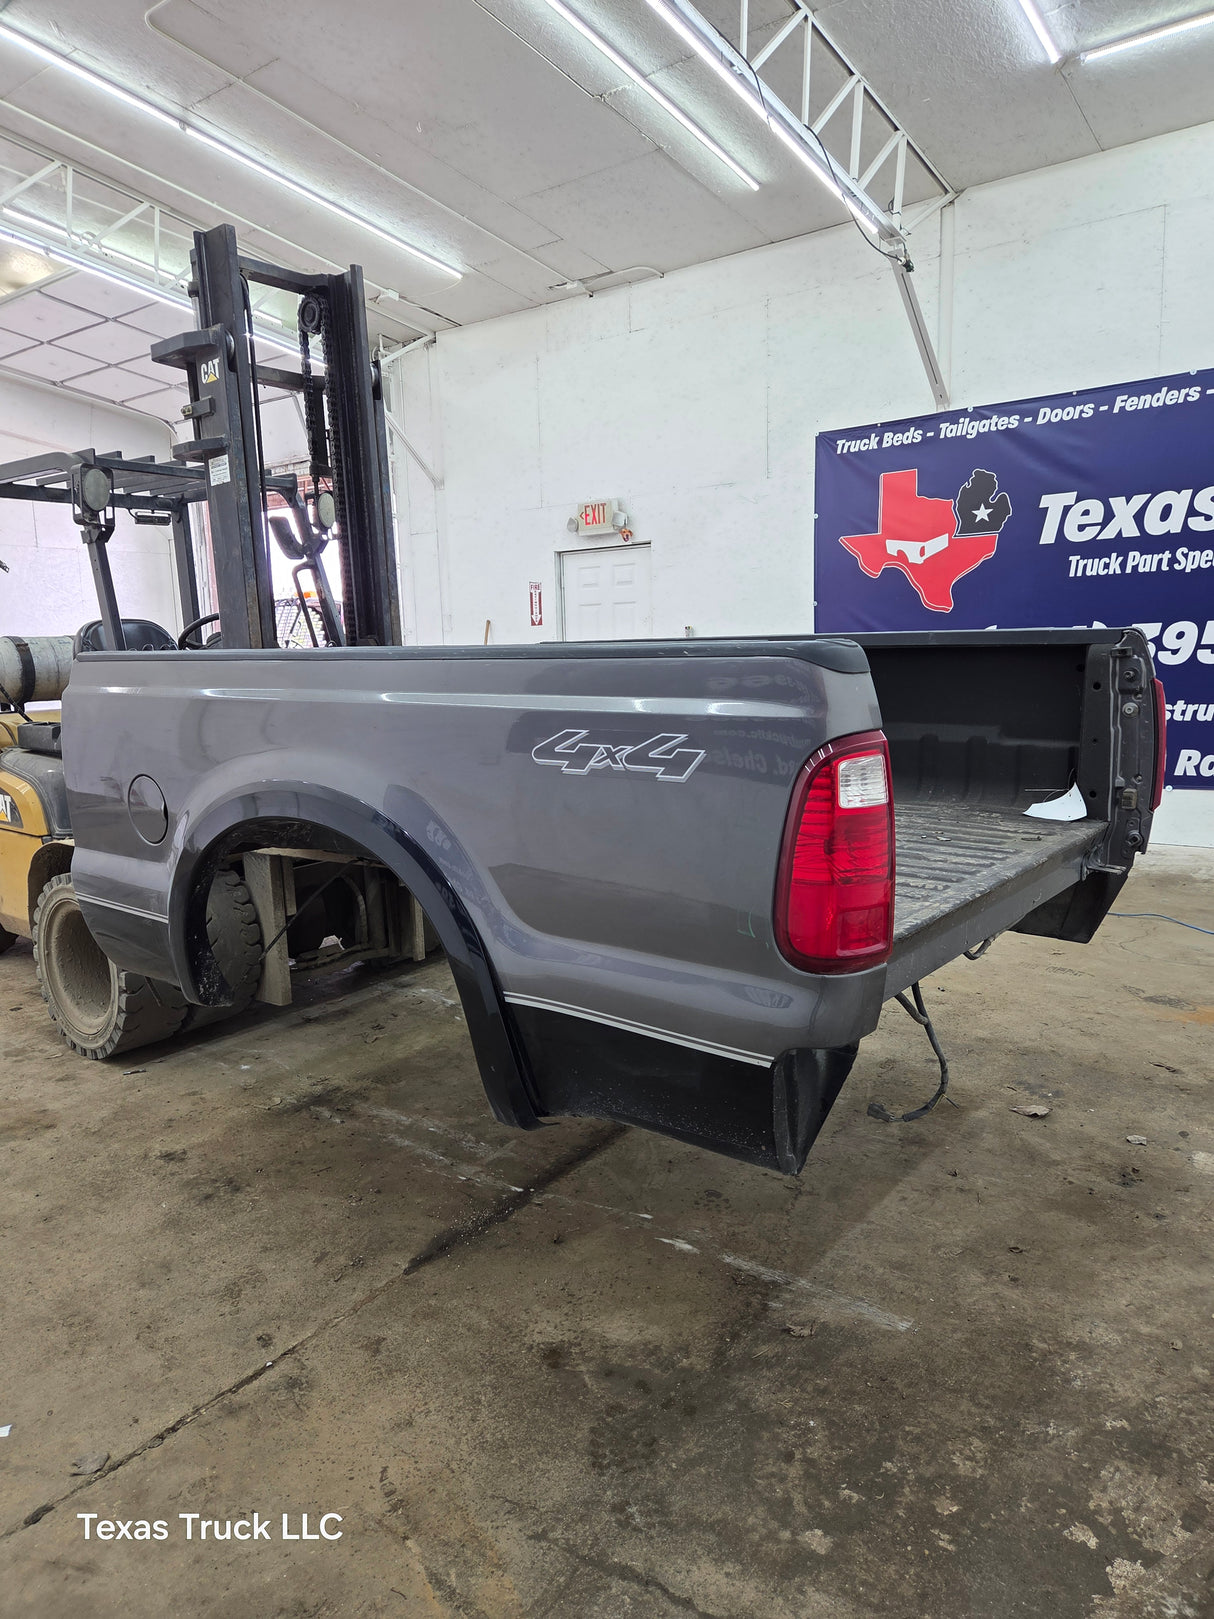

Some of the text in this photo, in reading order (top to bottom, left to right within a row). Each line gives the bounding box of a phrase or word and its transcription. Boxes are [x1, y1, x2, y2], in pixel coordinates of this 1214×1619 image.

[200, 358, 220, 384] CAT
[836, 433, 880, 455] Truck
[882, 427, 923, 448] Beds
[939, 414, 1020, 439] Tailgates
[1036, 403, 1095, 425] Doors
[1112, 386, 1201, 414] Fenders
[584, 502, 607, 525] EXIT
[1038, 485, 1214, 545] Texas
[1068, 546, 1214, 577] Truck Part Spe
[531, 729, 707, 783] 4x4
